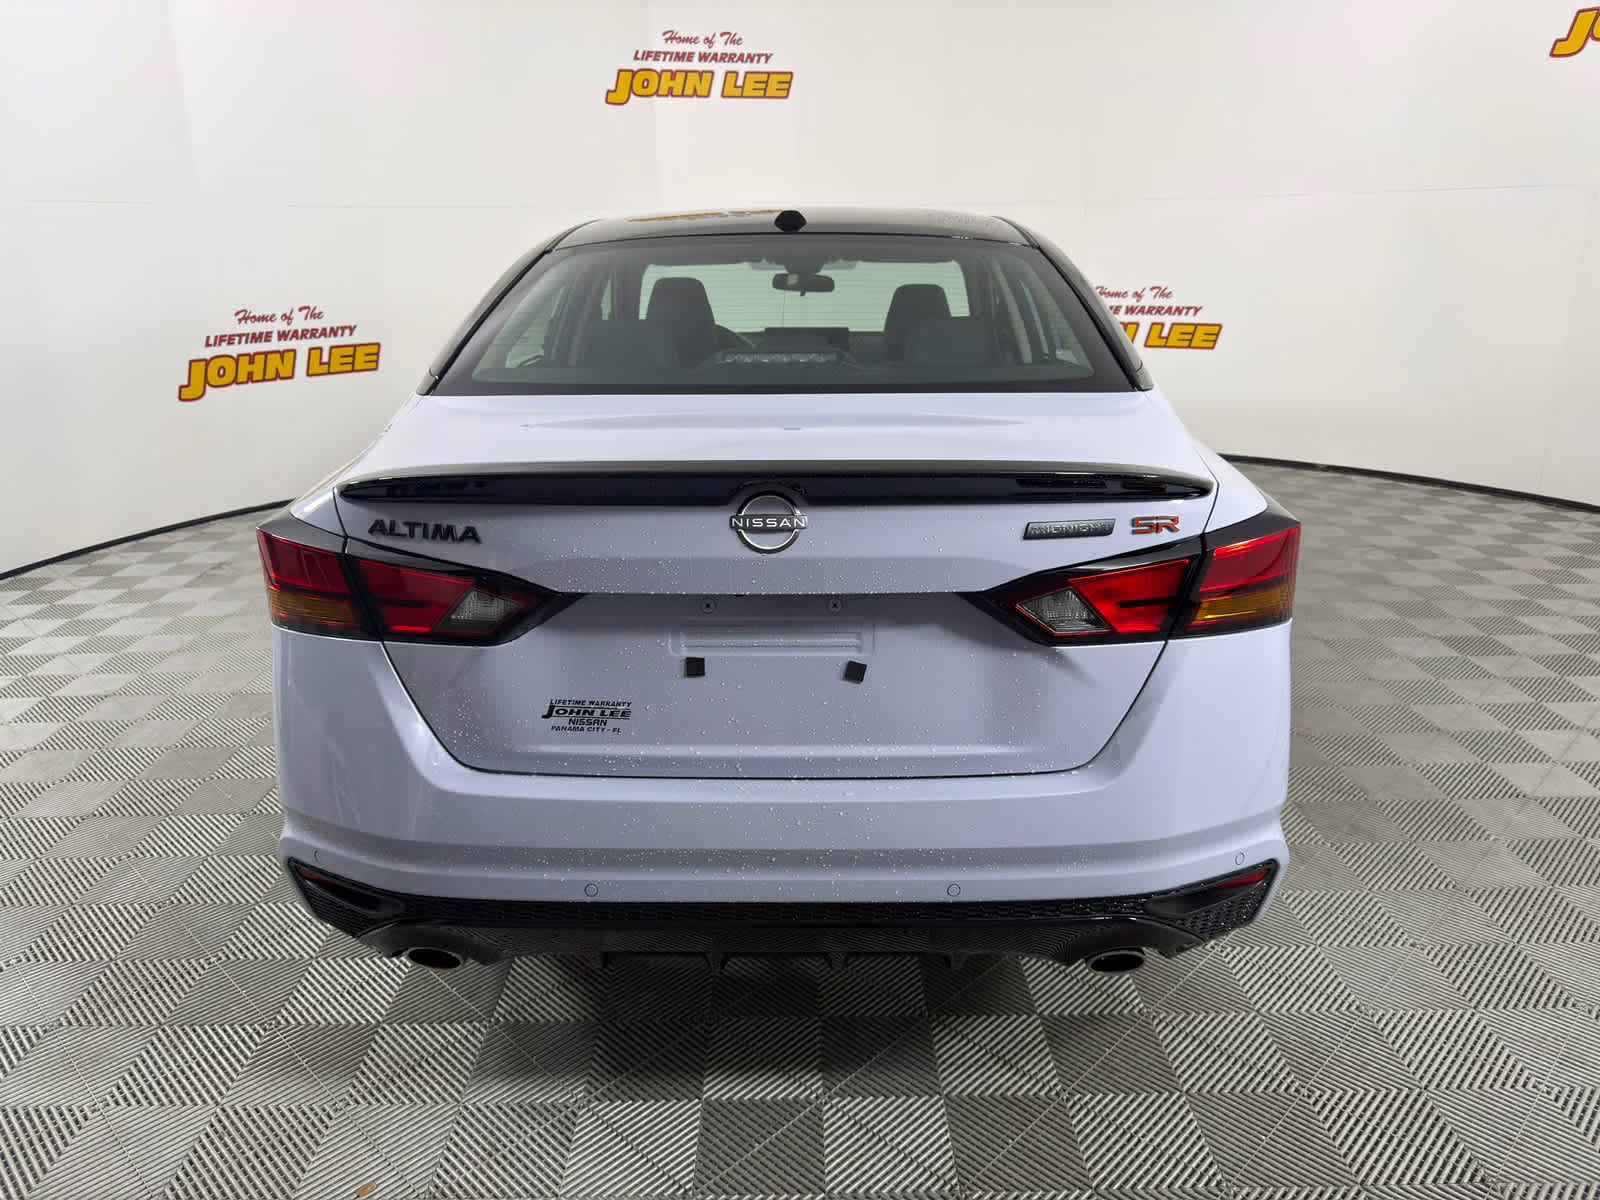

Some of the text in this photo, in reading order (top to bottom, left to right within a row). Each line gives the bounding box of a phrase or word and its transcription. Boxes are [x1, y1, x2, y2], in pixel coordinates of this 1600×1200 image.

[662, 30, 743, 48] Home of The
[633, 50, 773, 64] LIFETIME WARRANTY
[605, 68, 793, 105] JOHN LEE
[1132, 287, 1146, 302] of
[1150, 286, 1173, 299] The
[234, 305, 324, 325] Home of The
[1125, 305, 1203, 316] WARRANTY
[204, 325, 357, 348] LIFETIME WARRANTY
[1144, 322, 1222, 350] LEE
[178, 342, 381, 402] JOHN LEE
[368, 519, 482, 544] ALTIMA
[731, 518, 806, 528] NISSAN
[1131, 516, 1180, 535] SR
[541, 704, 632, 719] JOHN LEE
